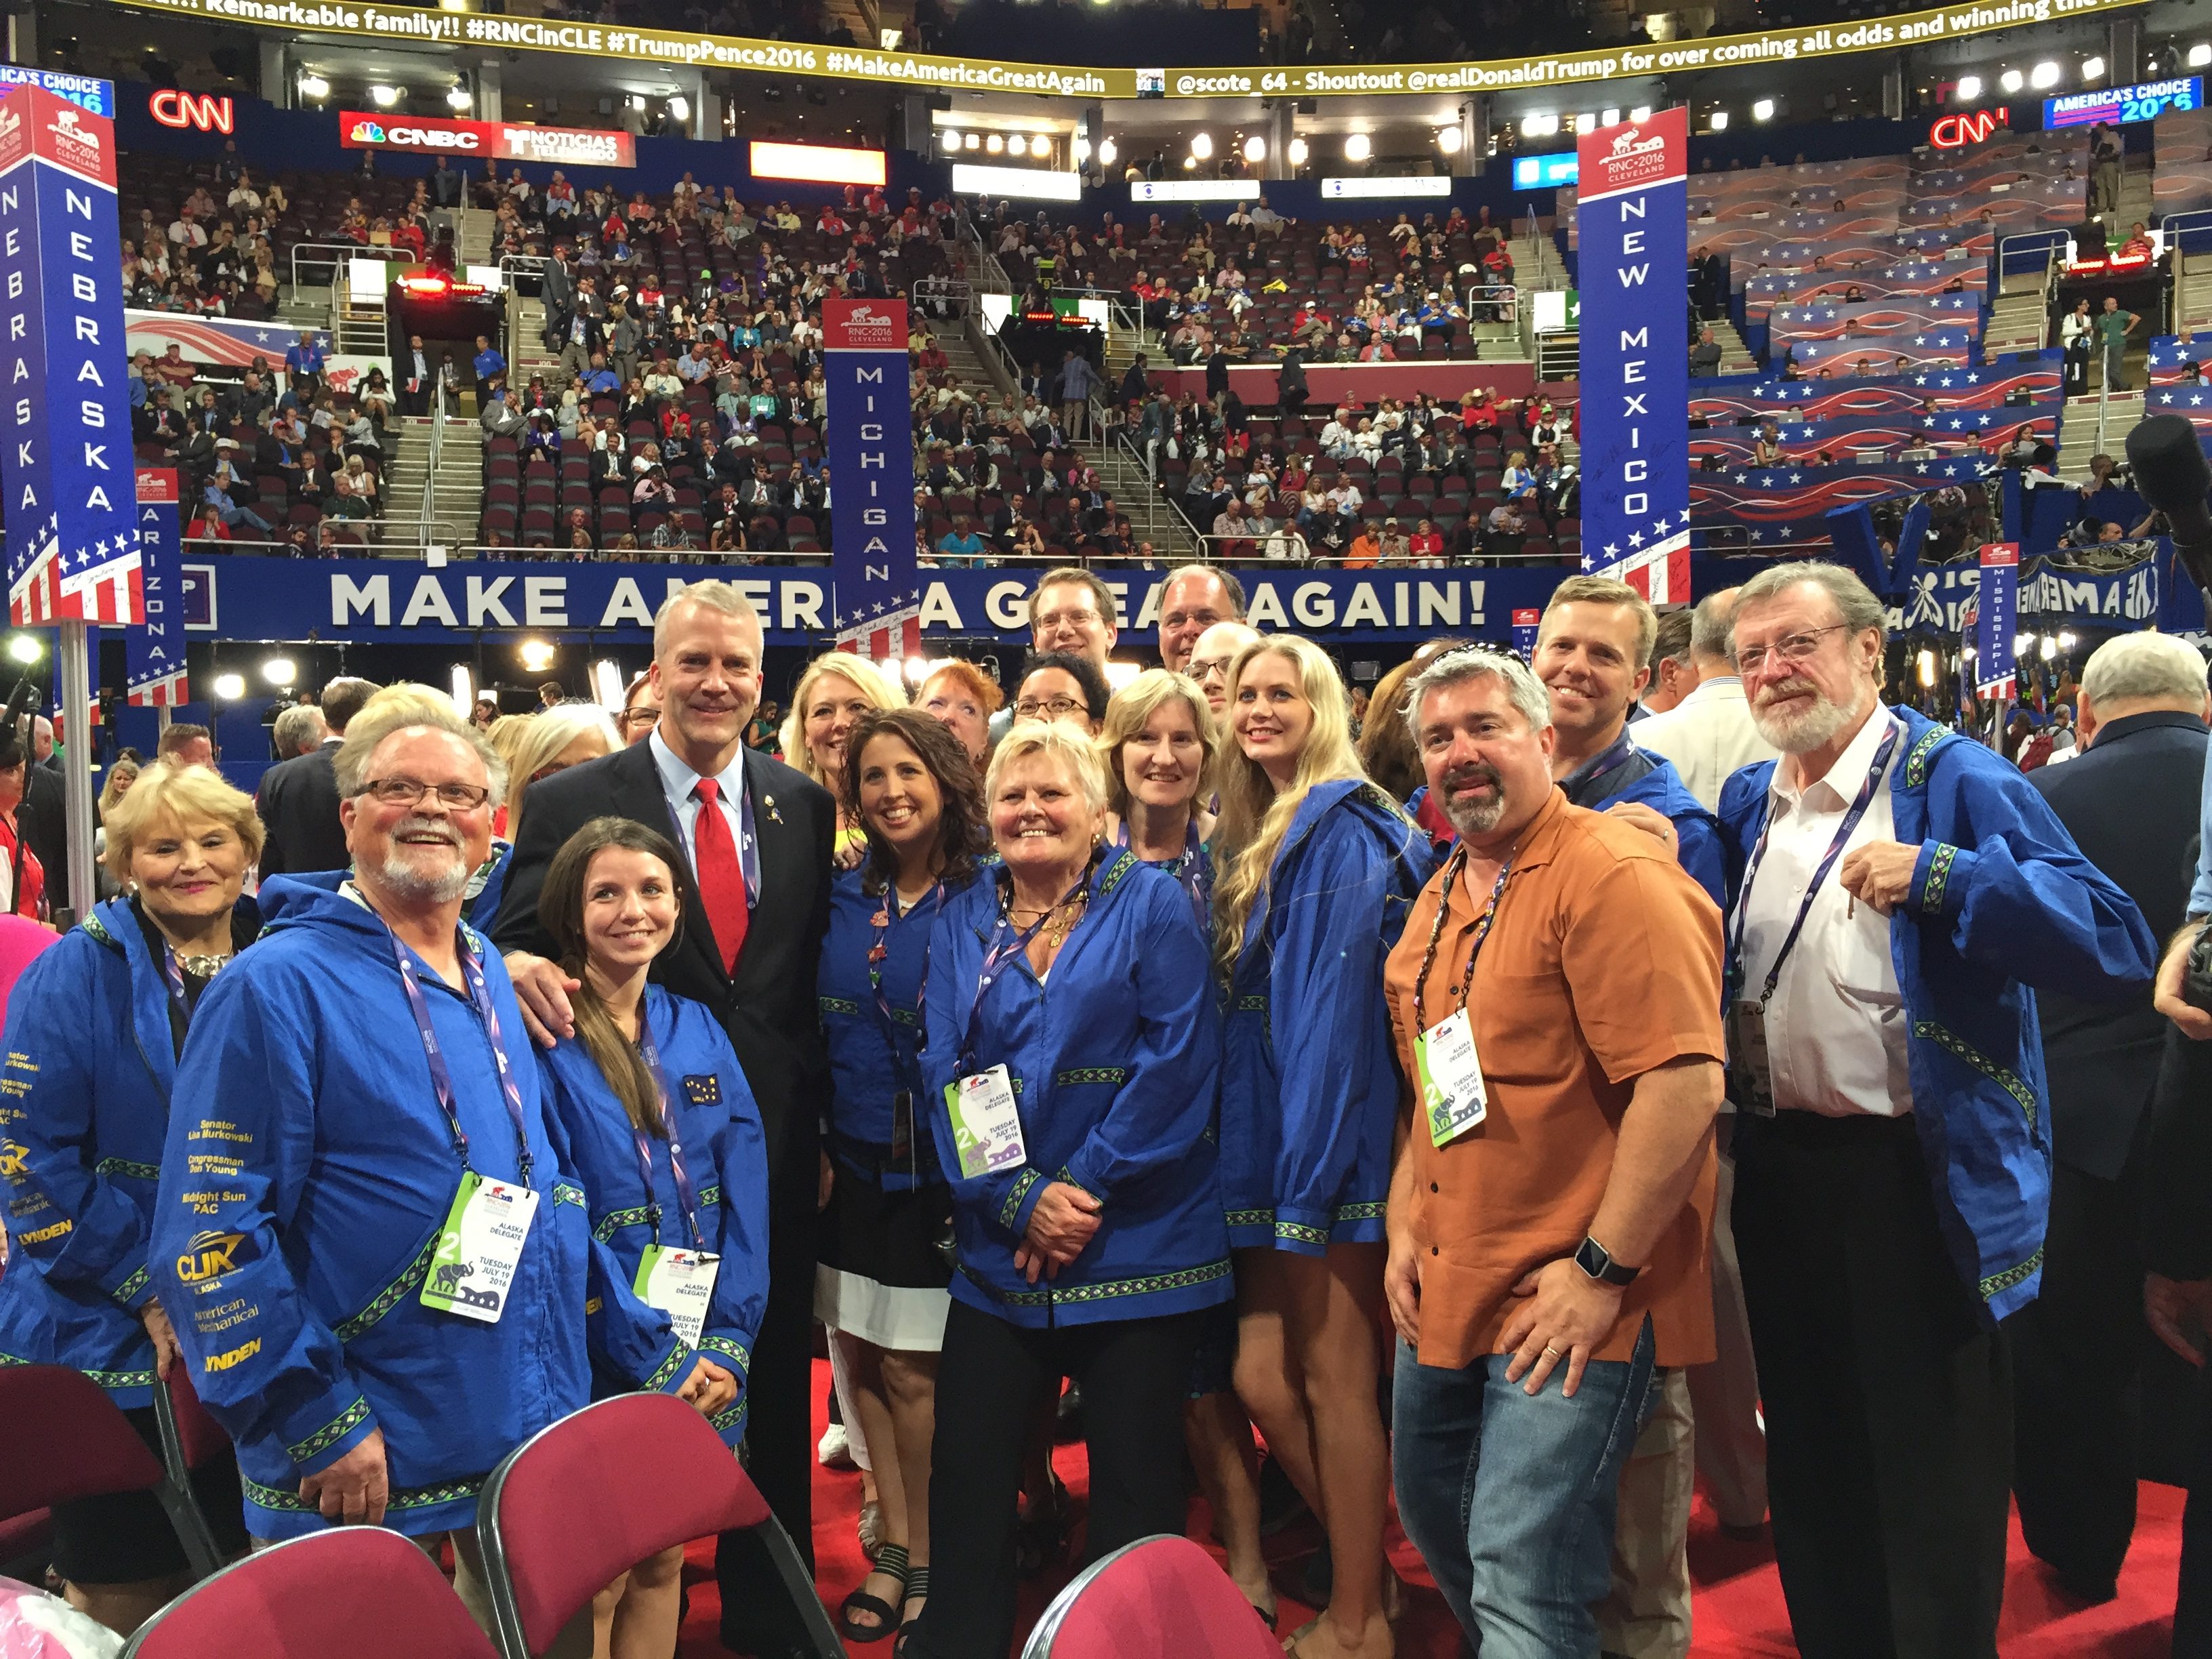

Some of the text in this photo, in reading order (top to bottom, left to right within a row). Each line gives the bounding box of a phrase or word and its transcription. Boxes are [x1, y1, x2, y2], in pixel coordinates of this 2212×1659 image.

[206, 0, 1105, 96] Remarkable family!! #RNCinCLE #TrumpPence2016 #MakeAmericaGreatAgain
[1177, 72, 1288, 96] @scote_64
[1305, 71, 1403, 90] Shoutout
[1408, 56, 1617, 91] @realDonaldTrump
[1621, 52, 1655, 71] for
[1659, 48, 1709, 67] over
[1713, 37, 1797, 59] coming
[1803, 30, 1832, 52] all
[1837, 22, 1894, 47] odds
[1900, 18, 1944, 39] and
[1950, 0, 2049, 30] winning
[44, 74, 101, 94] CHOICE
[2053, 79, 2192, 112] AMERICA'S CHOICE
[149, 89, 234, 134] CNN
[2122, 94, 2192, 121] 206
[1930, 108, 2009, 149] CNN
[388, 127, 478, 148] CNBC
[531, 130, 617, 150] NOTICIAS
[1608, 164, 1664, 182] CLEVELAND
[2, 185, 38, 510] NEBRASKA
[66, 188, 112, 512] NEBRASKA
[1618, 197, 1650, 515] NEW MEXICO
[857, 367, 888, 582] MICHIGAN
[142, 508, 166, 659] ARIZONA
[330, 574, 569, 628] MAKE
[1244, 580, 1486, 628] AGAIN!
[1992, 569, 2005, 668] MISSISSIPPI
[1449, 1046, 1471, 1063] DELEGATE
[1452, 1040, 1470, 1054] ALASKA
[1453, 1071, 1476, 1088] TUESDAY
[1458, 1082, 1471, 1093] JULY
[989, 1092, 1009, 1103] ALASKA
[1425, 1082, 1439, 1108] 2
[1467, 1085, 1479, 1096] 2016
[985, 1097, 1010, 1110] DELEGATE
[989, 1119, 1015, 1134] TUESDAY
[996, 1128, 1009, 1138] JULY
[202, 1129, 253, 1143] Murkowski
[956, 1127, 972, 1150] 2
[1005, 1132, 1019, 1141] 2016
[205, 1163, 238, 1176] Young
[222, 1191, 246, 1202] Sun
[193, 1204, 219, 1214] PAC
[18, 1218, 73, 1246] LYNDEN
[490, 1227, 522, 1241] DELEGATE
[499, 1222, 523, 1233] ALASKA
[437, 1231, 459, 1261] 2
[480, 1256, 513, 1271] TUESDAY
[482, 1267, 510, 1279] JULY 19
[489, 1277, 507, 1288] 2016
[684, 1283, 708, 1292] ALASKA
[676, 1288, 707, 1297] DELEGATE
[670, 1313, 701, 1324] TUESDAY
[680, 1330, 697, 1338] 2016
[205, 1337, 262, 1372] YNDEN
